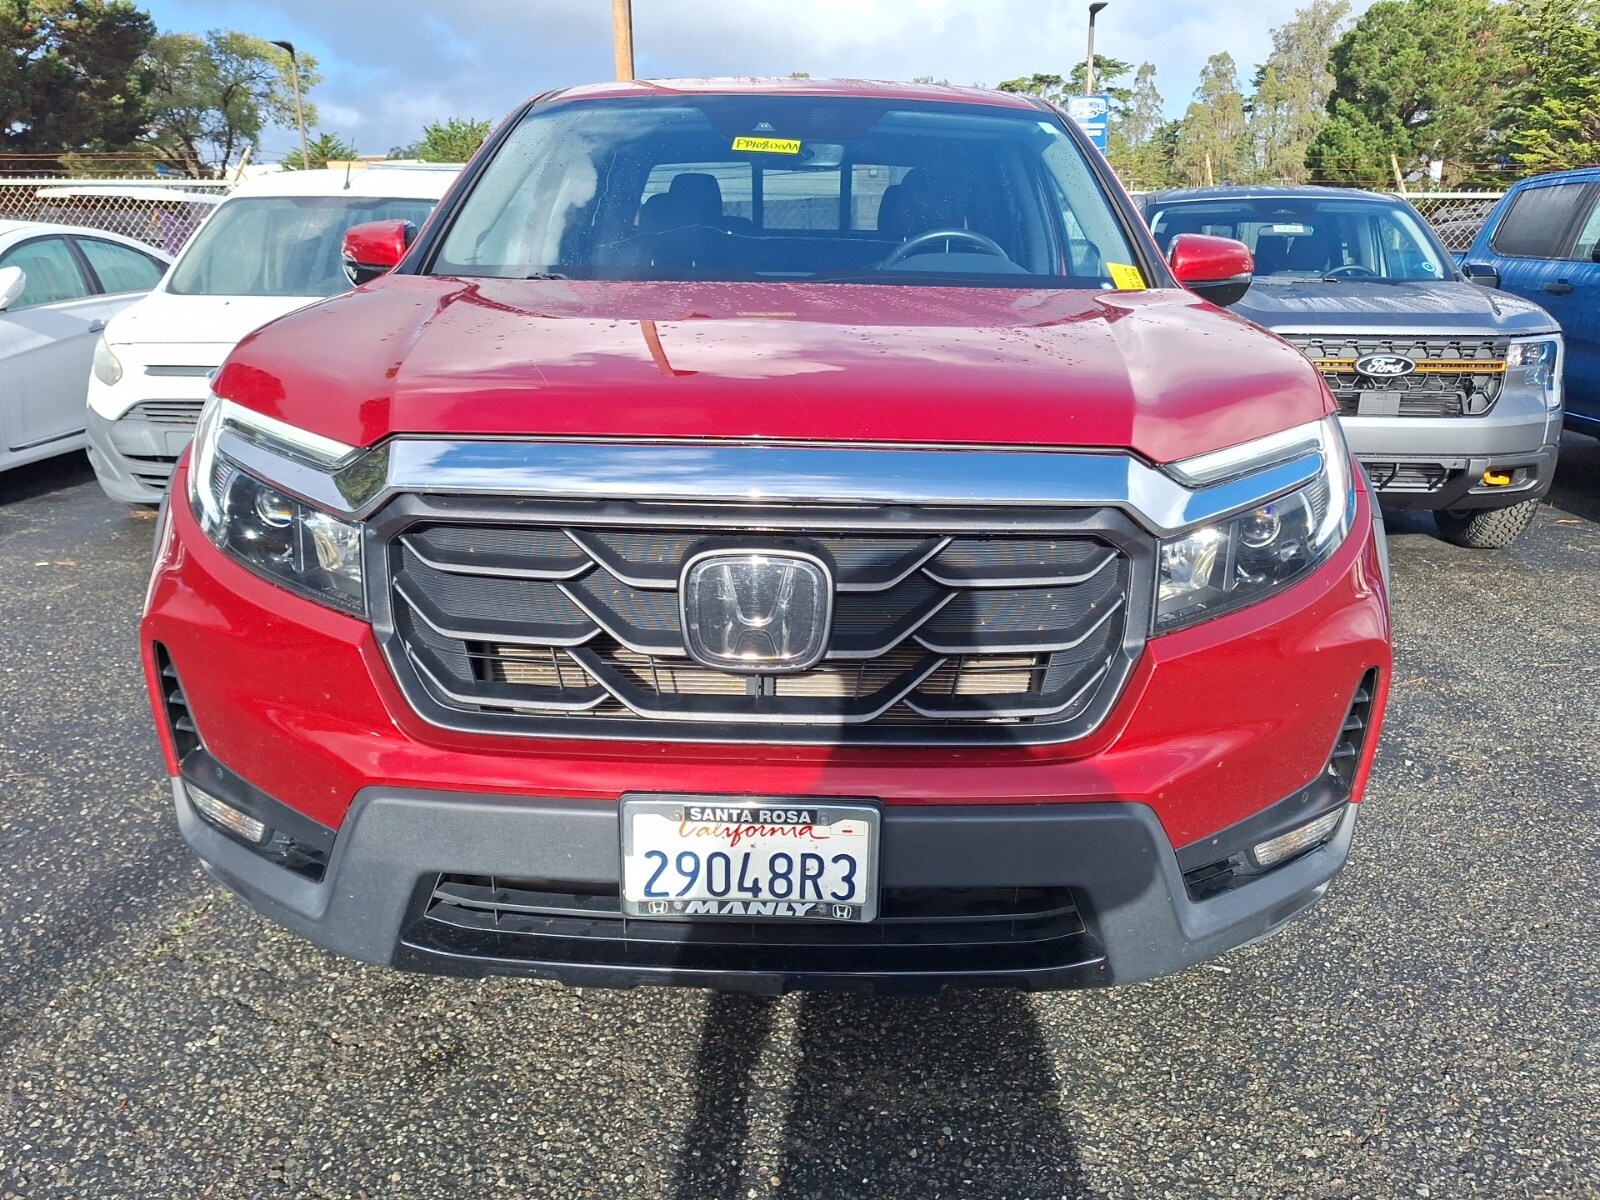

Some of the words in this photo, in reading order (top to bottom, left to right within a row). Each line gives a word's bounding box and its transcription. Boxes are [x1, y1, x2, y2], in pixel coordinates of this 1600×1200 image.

[1367, 357, 1405, 373] Ford
[690, 808, 751, 823] SANTA
[759, 810, 812, 824] ROSA
[679, 821, 830, 848] California
[644, 850, 857, 901] 29048R3
[684, 901, 816, 917] MANLY
